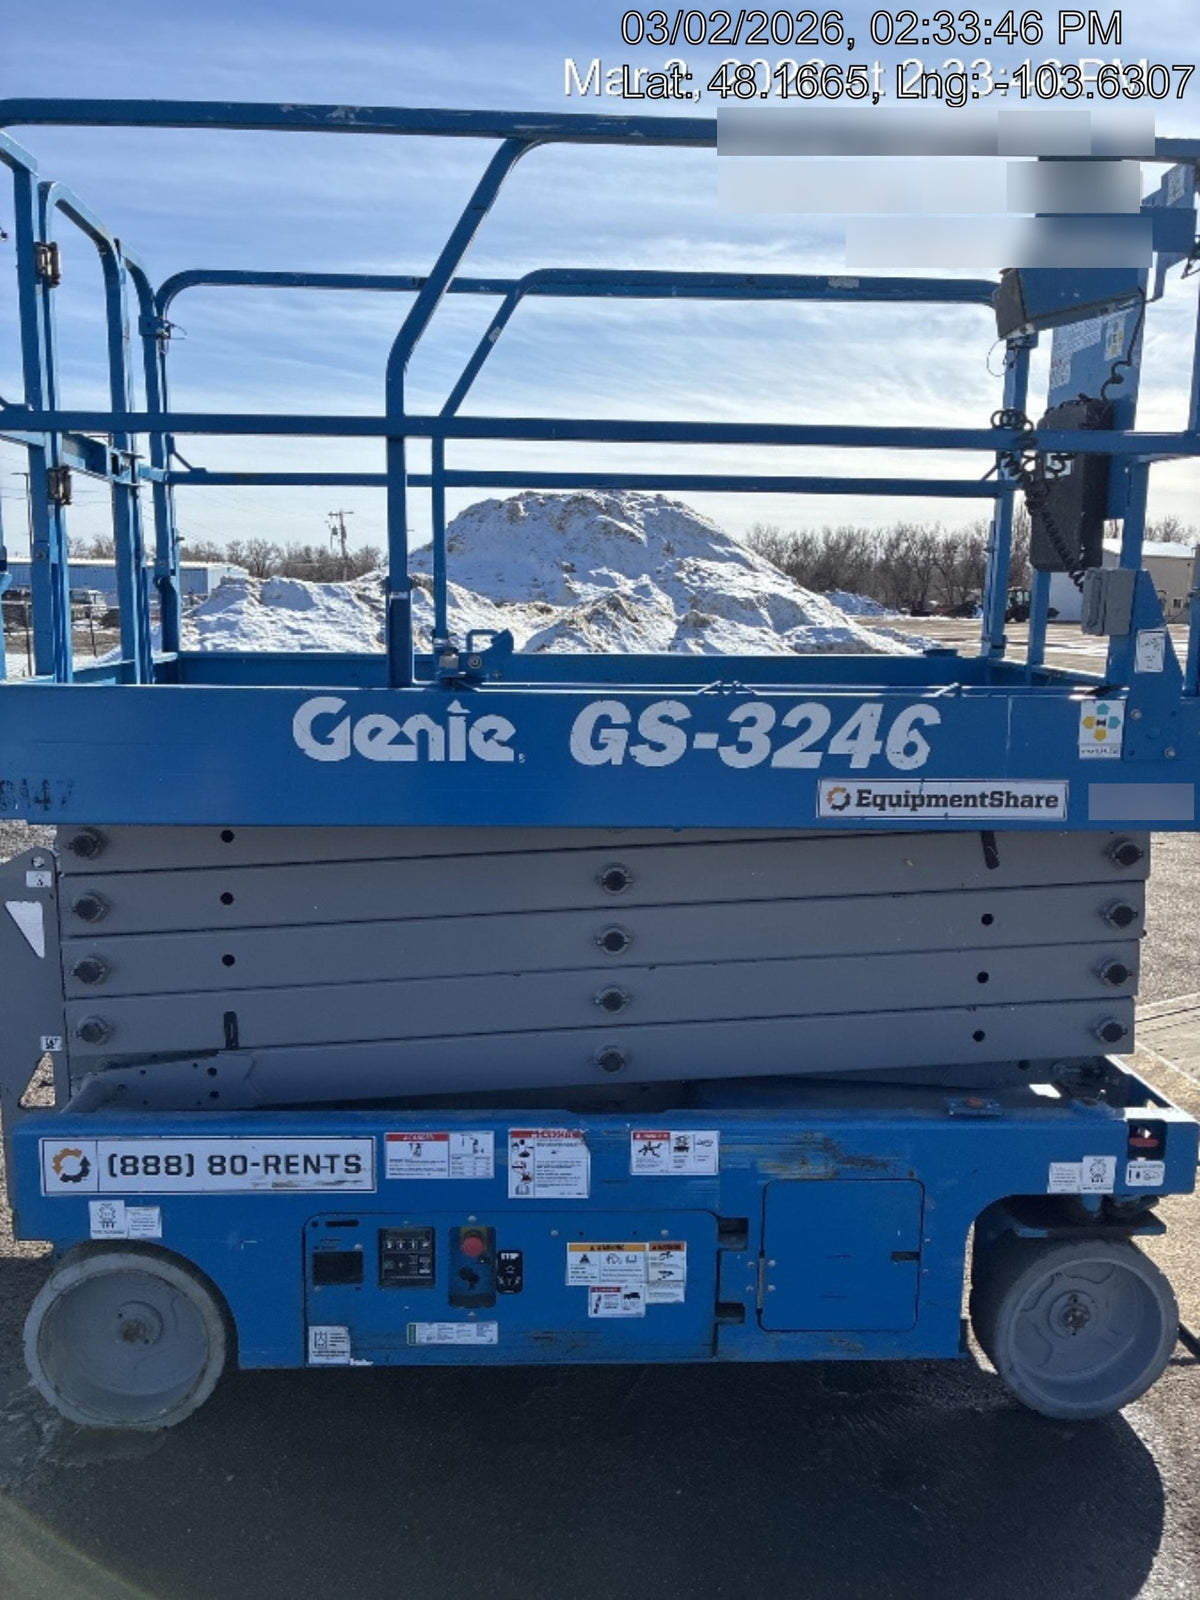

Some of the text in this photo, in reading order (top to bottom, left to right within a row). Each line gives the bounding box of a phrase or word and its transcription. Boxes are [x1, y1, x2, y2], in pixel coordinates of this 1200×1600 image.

[292, 696, 942, 770] Genie GS-3246
[855, 787, 1060, 812] EquipmentShare
[108, 1153, 195, 1178] (888)
[206, 1153, 363, 1176] 80-RENTS
